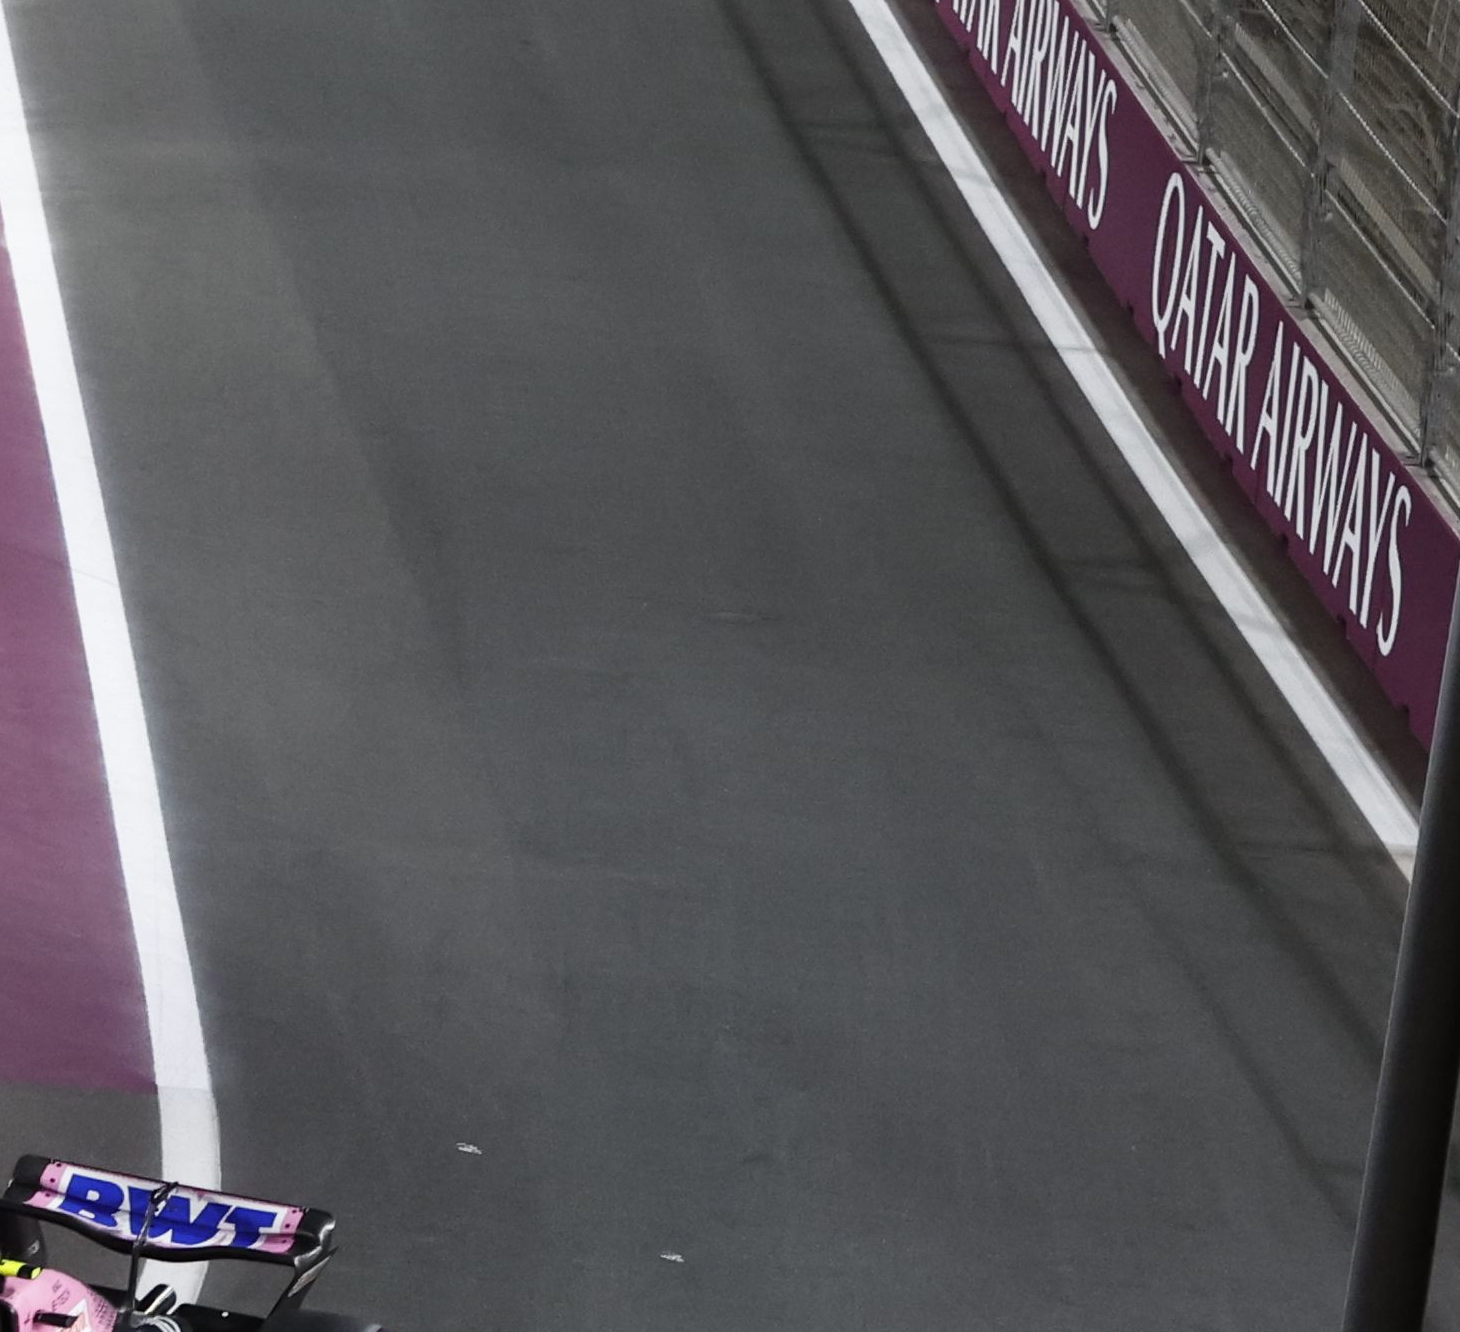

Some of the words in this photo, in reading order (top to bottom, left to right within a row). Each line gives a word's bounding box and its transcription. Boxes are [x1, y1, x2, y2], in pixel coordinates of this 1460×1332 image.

[1151, 172, 1260, 452] QATAR
[1251, 322, 1411, 657] AIRWAYS
[57, 1173, 278, 1248] BWT
